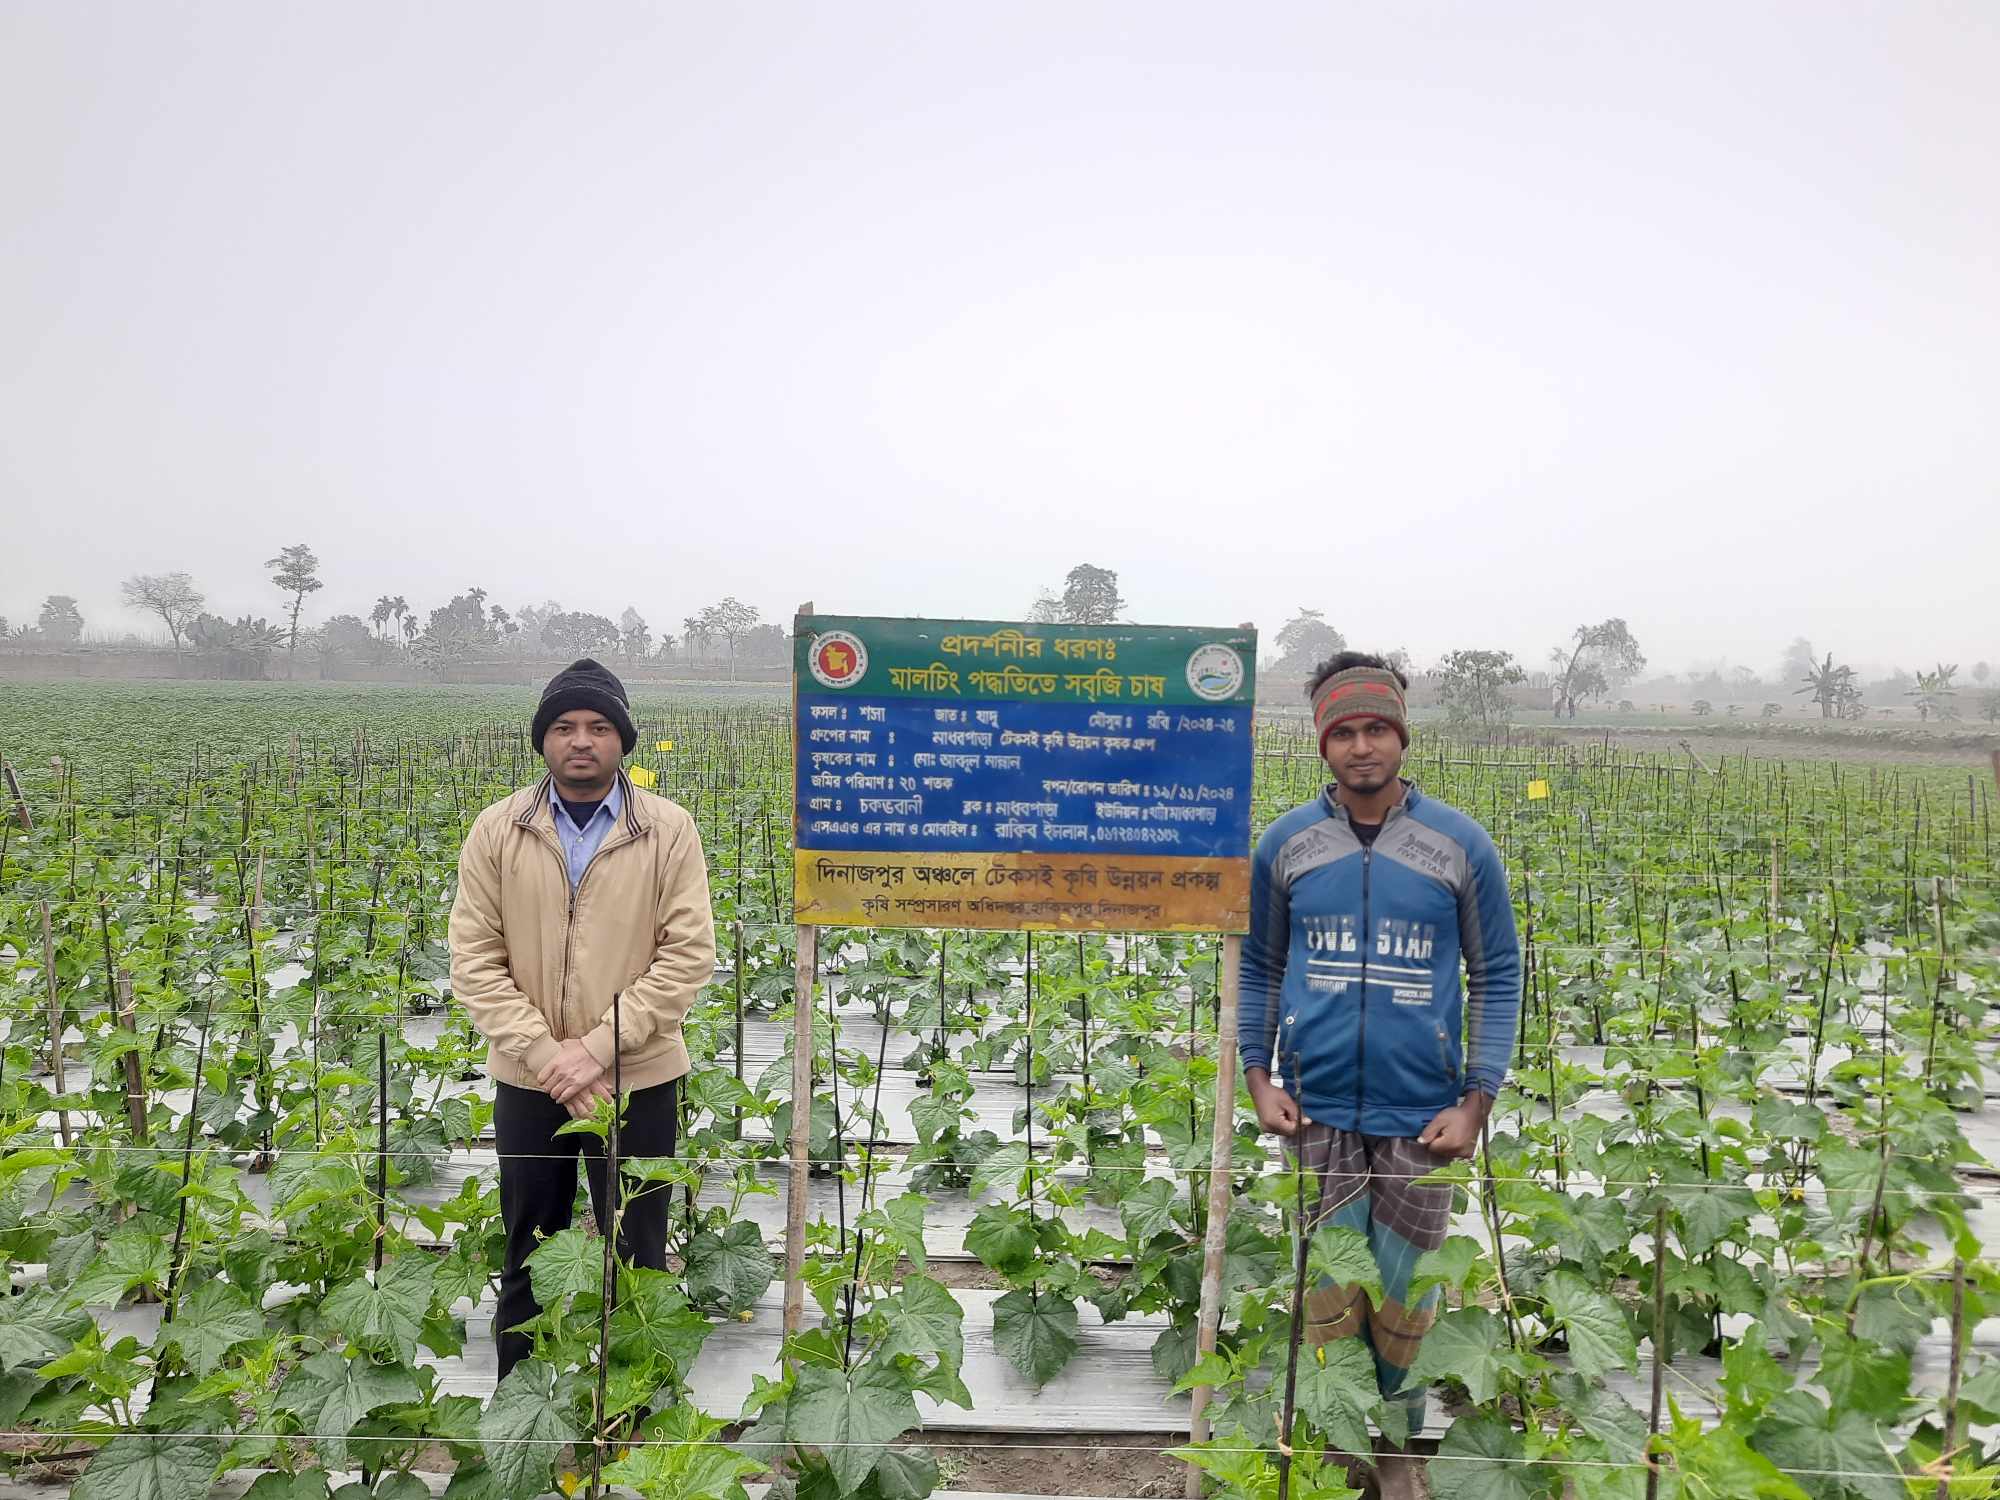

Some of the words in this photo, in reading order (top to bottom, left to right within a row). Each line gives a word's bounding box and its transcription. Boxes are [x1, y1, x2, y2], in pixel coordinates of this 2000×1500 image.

[940, 629, 1043, 658] প্রদর্শনীর
[888, 661, 961, 695] মালচিং
[968, 665, 1058, 694] পদ্ধতিতে
[1128, 674, 1167, 698] চাষ
[810, 704, 838, 720] ফসল
[858, 705, 886, 722] শসা
[934, 708, 958, 722] জাত
[1147, 710, 1170, 731] রবি
[850, 729, 872, 743] নাম
[1000, 729, 1040, 748] টেকসই
[1042, 730, 1065, 752] কৃষি
[1066, 732, 1100, 750] উন্নয়ন
[811, 752, 852, 772] কৃষকের
[855, 752, 877, 767] নাম
[811, 771, 842, 789] জমির
[922, 776, 955, 790] শতক
[810, 797, 832, 812] গ্রাম
[863, 822, 881, 835] এর
[884, 821, 905, 836] নাম
[908, 825, 918, 836] ও
[922, 820, 968, 837] মোবাইল
[995, 818, 1038, 839] রাকিব
[817, 858, 906, 889] দিনাজপুর
[912, 866, 977, 886] অঞ্চলে
[985, 863, 1055, 889] টেকসই
[1062, 863, 1099, 896] কৃষি
[1106, 866, 1164, 892] উন্নয়ন
[1171, 870, 1222, 891] প্রকল্প
[862, 895, 889, 917] কৃষি
[895, 897, 962, 914] সম্প্রসারণ
[1376, 917, 1435, 960] STAR
